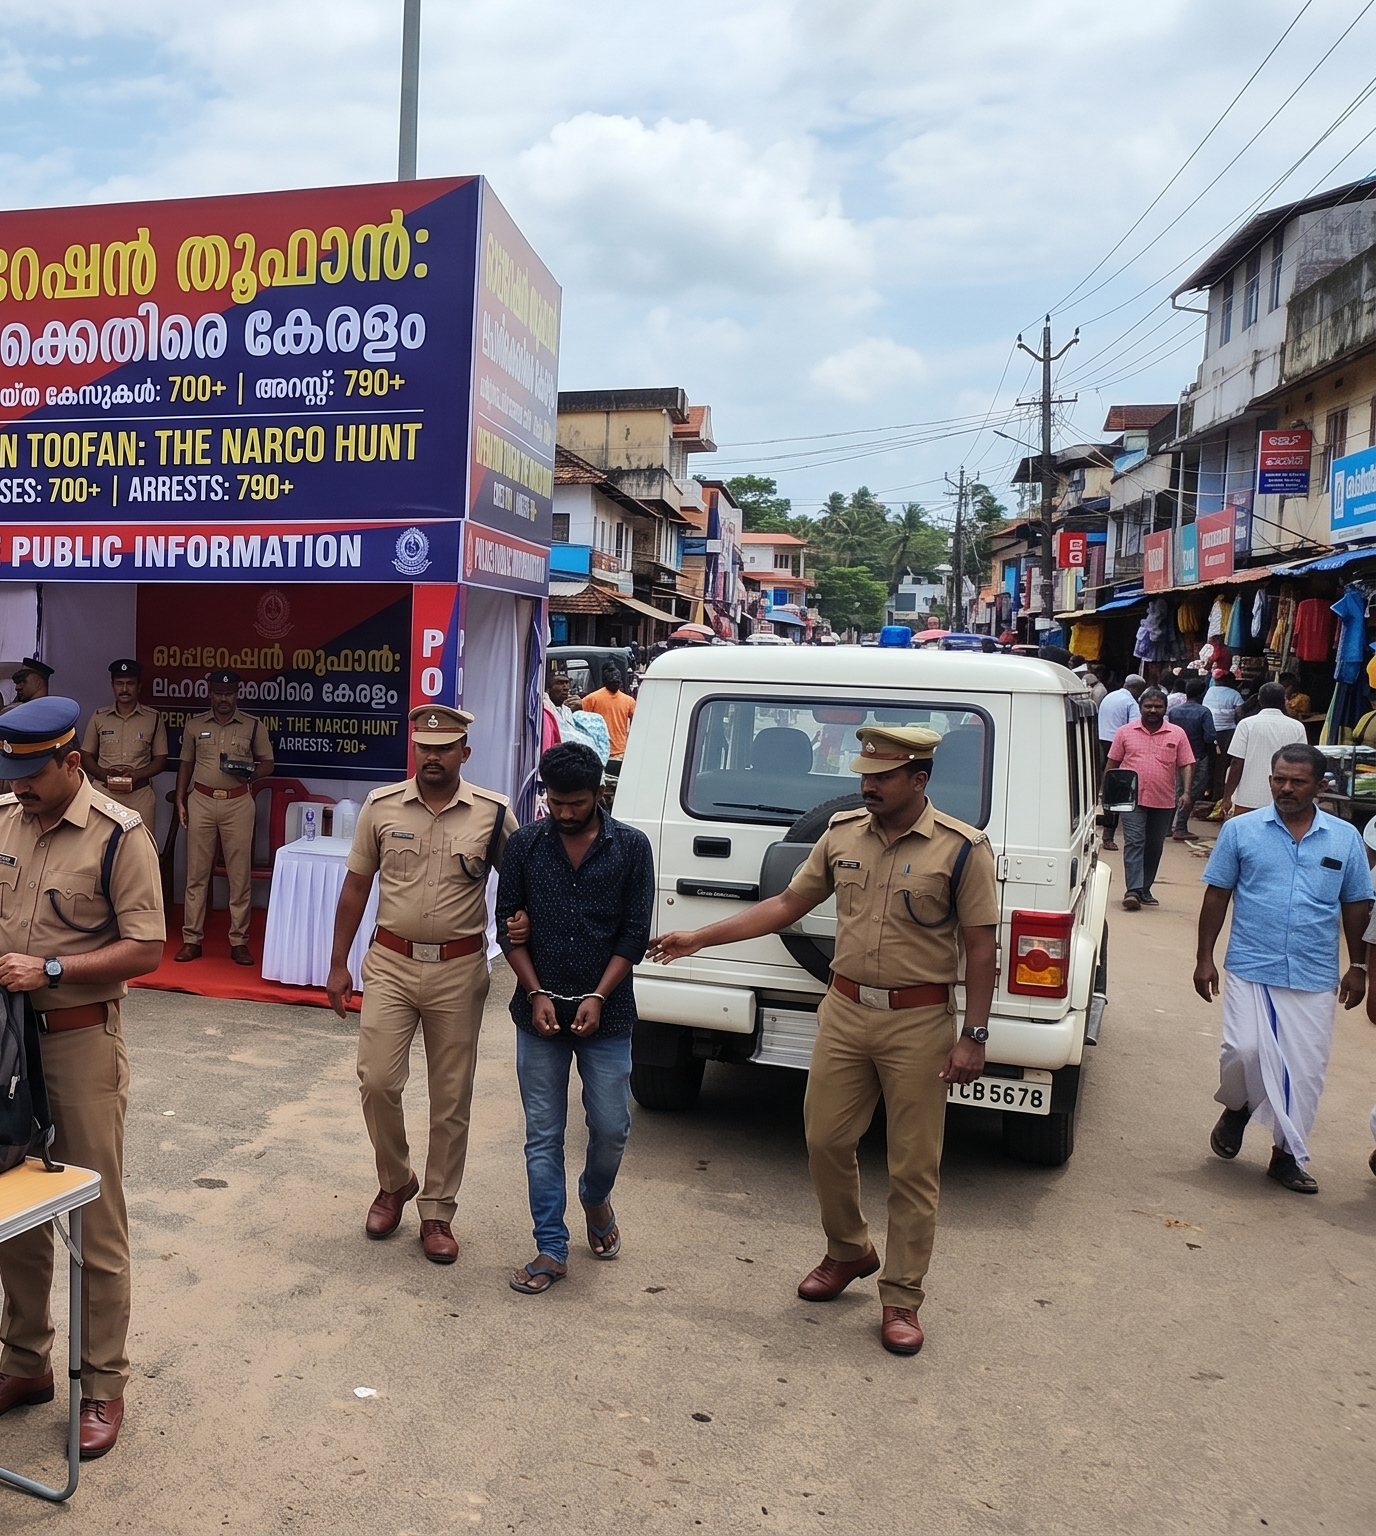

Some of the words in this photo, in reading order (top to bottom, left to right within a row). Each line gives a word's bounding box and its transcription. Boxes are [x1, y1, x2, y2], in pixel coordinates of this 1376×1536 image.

[176, 208, 429, 304] തൂഫാൻ:
[244, 304, 426, 363] കേരളം
[46, 377, 161, 410] കേസുകൾ:
[168, 375, 227, 403] 700+
[343, 368, 406, 397] 790+
[27, 431, 146, 468] TOOFAN:
[155, 429, 212, 465] THE
[221, 425, 325, 464] NARCO
[335, 423, 423, 462] HUNT
[48, 477, 101, 503] 700+
[128, 474, 230, 503] ARRESTS:
[236, 474, 294, 500] 790+
[11, 535, 122, 568] PUBLIC
[134, 534, 362, 569] INFORMATION
[322, 682, 399, 709] കേരളം
[278, 736, 333, 753] ARRESTS:
[286, 717, 312, 734] THE
[316, 717, 358, 736] NARCO
[361, 719, 399, 737] HUNT
